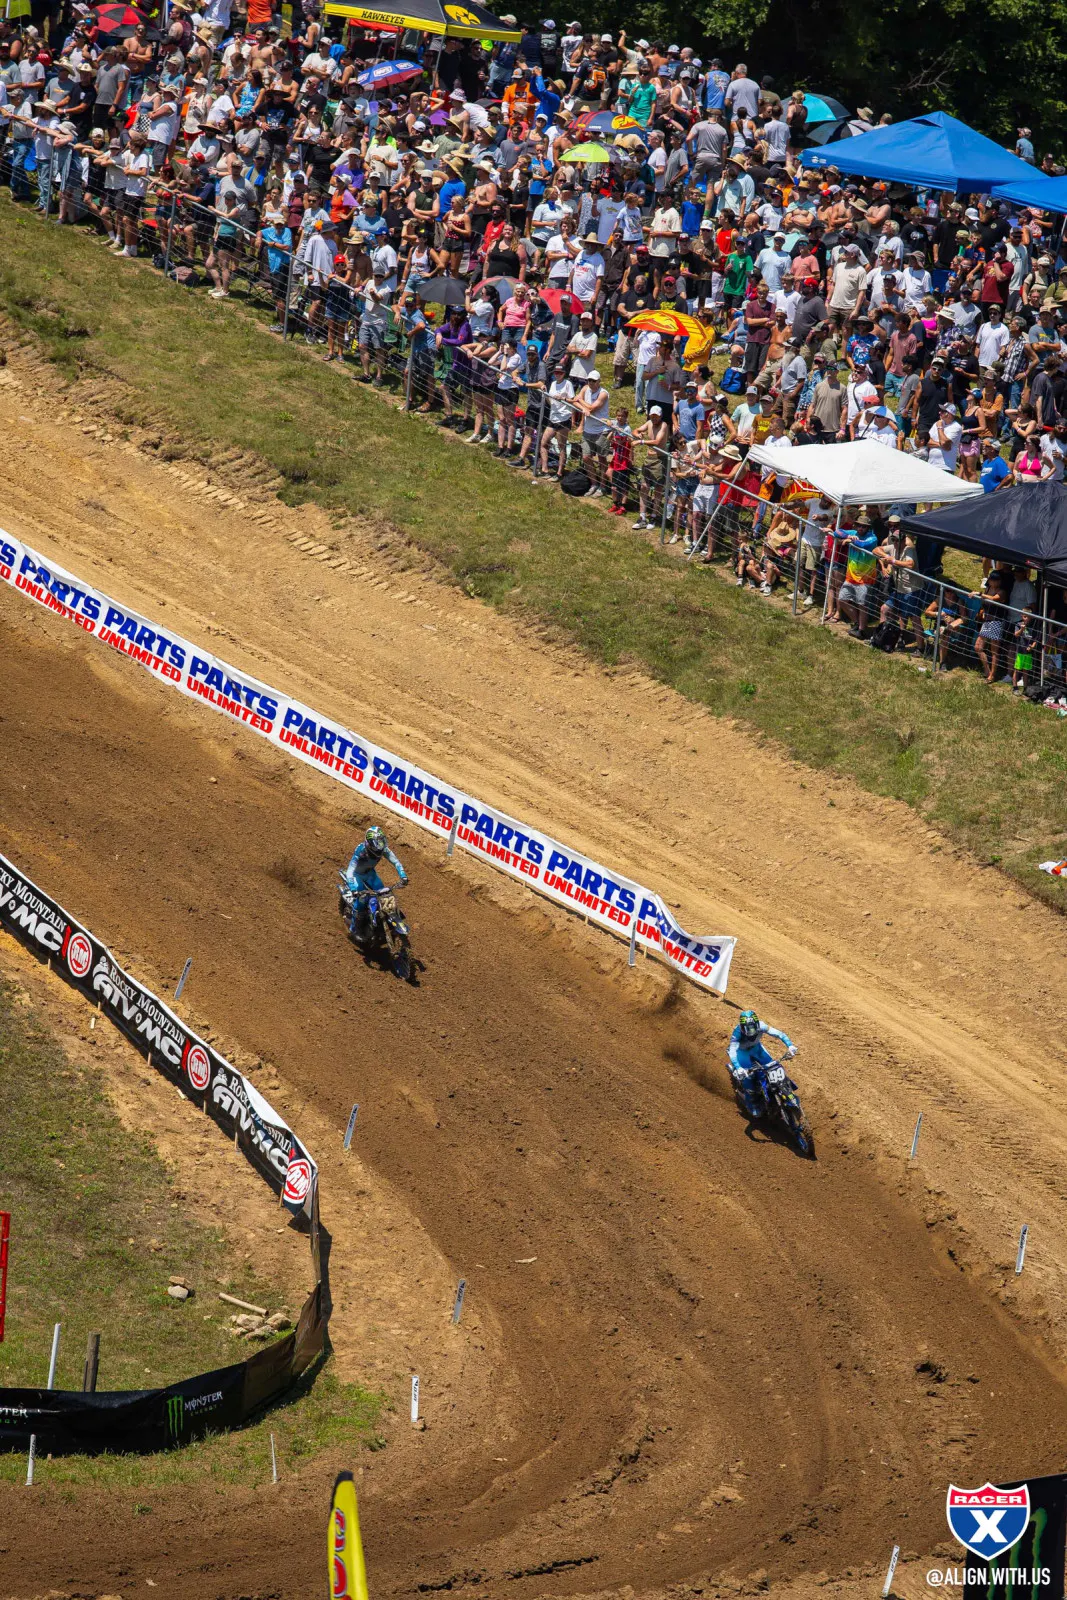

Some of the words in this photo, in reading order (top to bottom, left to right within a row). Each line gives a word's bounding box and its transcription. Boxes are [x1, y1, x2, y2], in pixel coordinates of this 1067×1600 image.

[361, 10, 406, 25] HAWKEYES
[19, 553, 102, 621] PARTS
[103, 606, 187, 670] PARTS
[189, 655, 279, 721] PARTS
[282, 706, 369, 771] PARTS
[372, 755, 456, 818] PARTS
[460, 803, 545, 865] PARTS
[546, 850, 637, 914] PARTS
[14, 573, 96, 633] UNLIMITED
[97, 626, 182, 683] UNLIMITED
[186, 676, 273, 734] UNLIMITED
[279, 727, 365, 784] UNLIMITED
[369, 776, 454, 831] UNLIMITED
[457, 824, 540, 879] UNLIMITED
[543, 870, 631, 927] UNLIMITED
[636, 919, 713, 978] UNIMITED
[12, 880, 67, 933] MOUNTAIN
[110, 965, 137, 1001] ROCKY
[137, 992, 187, 1046] MOUNTAIN
[184, 1391, 224, 1411] MONSTER
